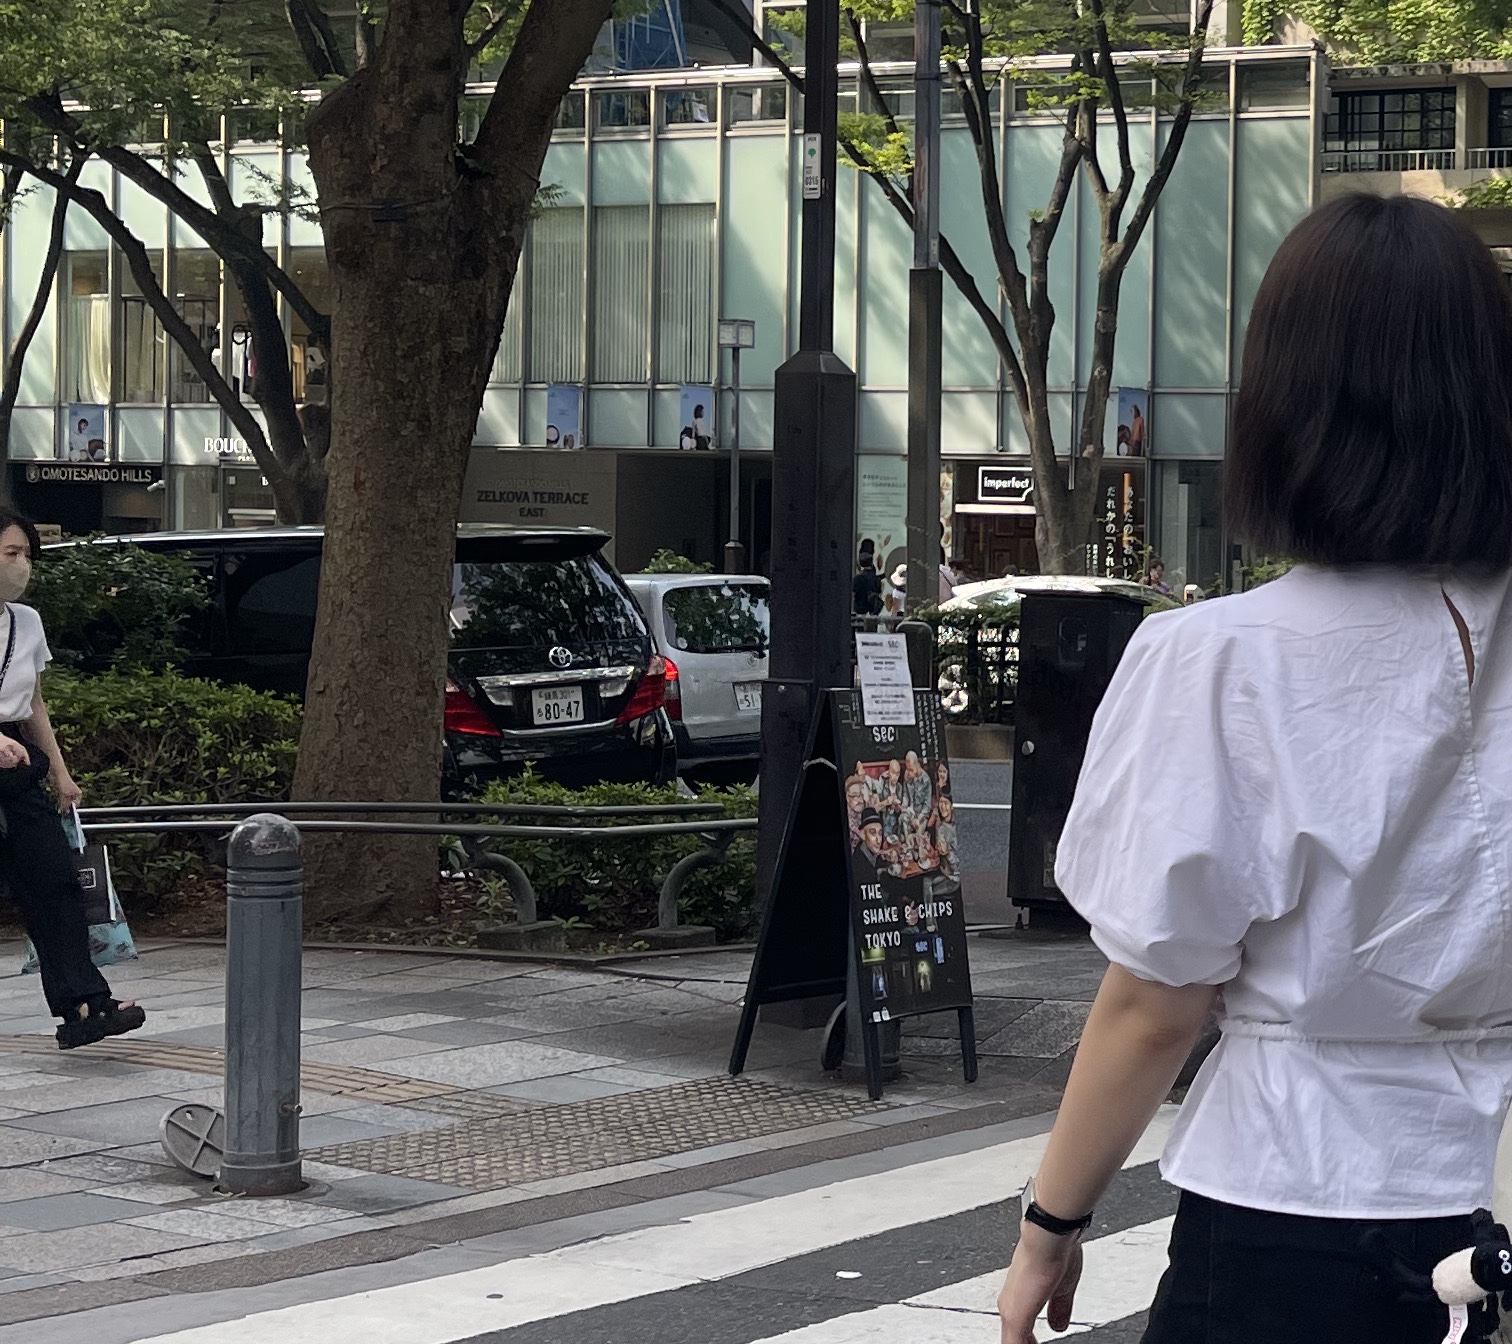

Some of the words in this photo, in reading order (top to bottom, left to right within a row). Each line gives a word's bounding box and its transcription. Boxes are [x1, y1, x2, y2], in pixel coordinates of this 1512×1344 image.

[41, 467, 119, 481] OMOTESANDO
[121, 469, 152, 482] HILLS
[983, 475, 1030, 490] imperfect
[477, 490, 530, 504] ZELKOVA
[533, 491, 590, 504] TERRACE
[519, 507, 546, 517] EAST
[545, 700, 580, 720] 80-47
[860, 883, 883, 900] THE
[863, 906, 899, 925] SHAKE
[918, 901, 953, 919] CHIPS
[865, 931, 901, 949] TOKYO
